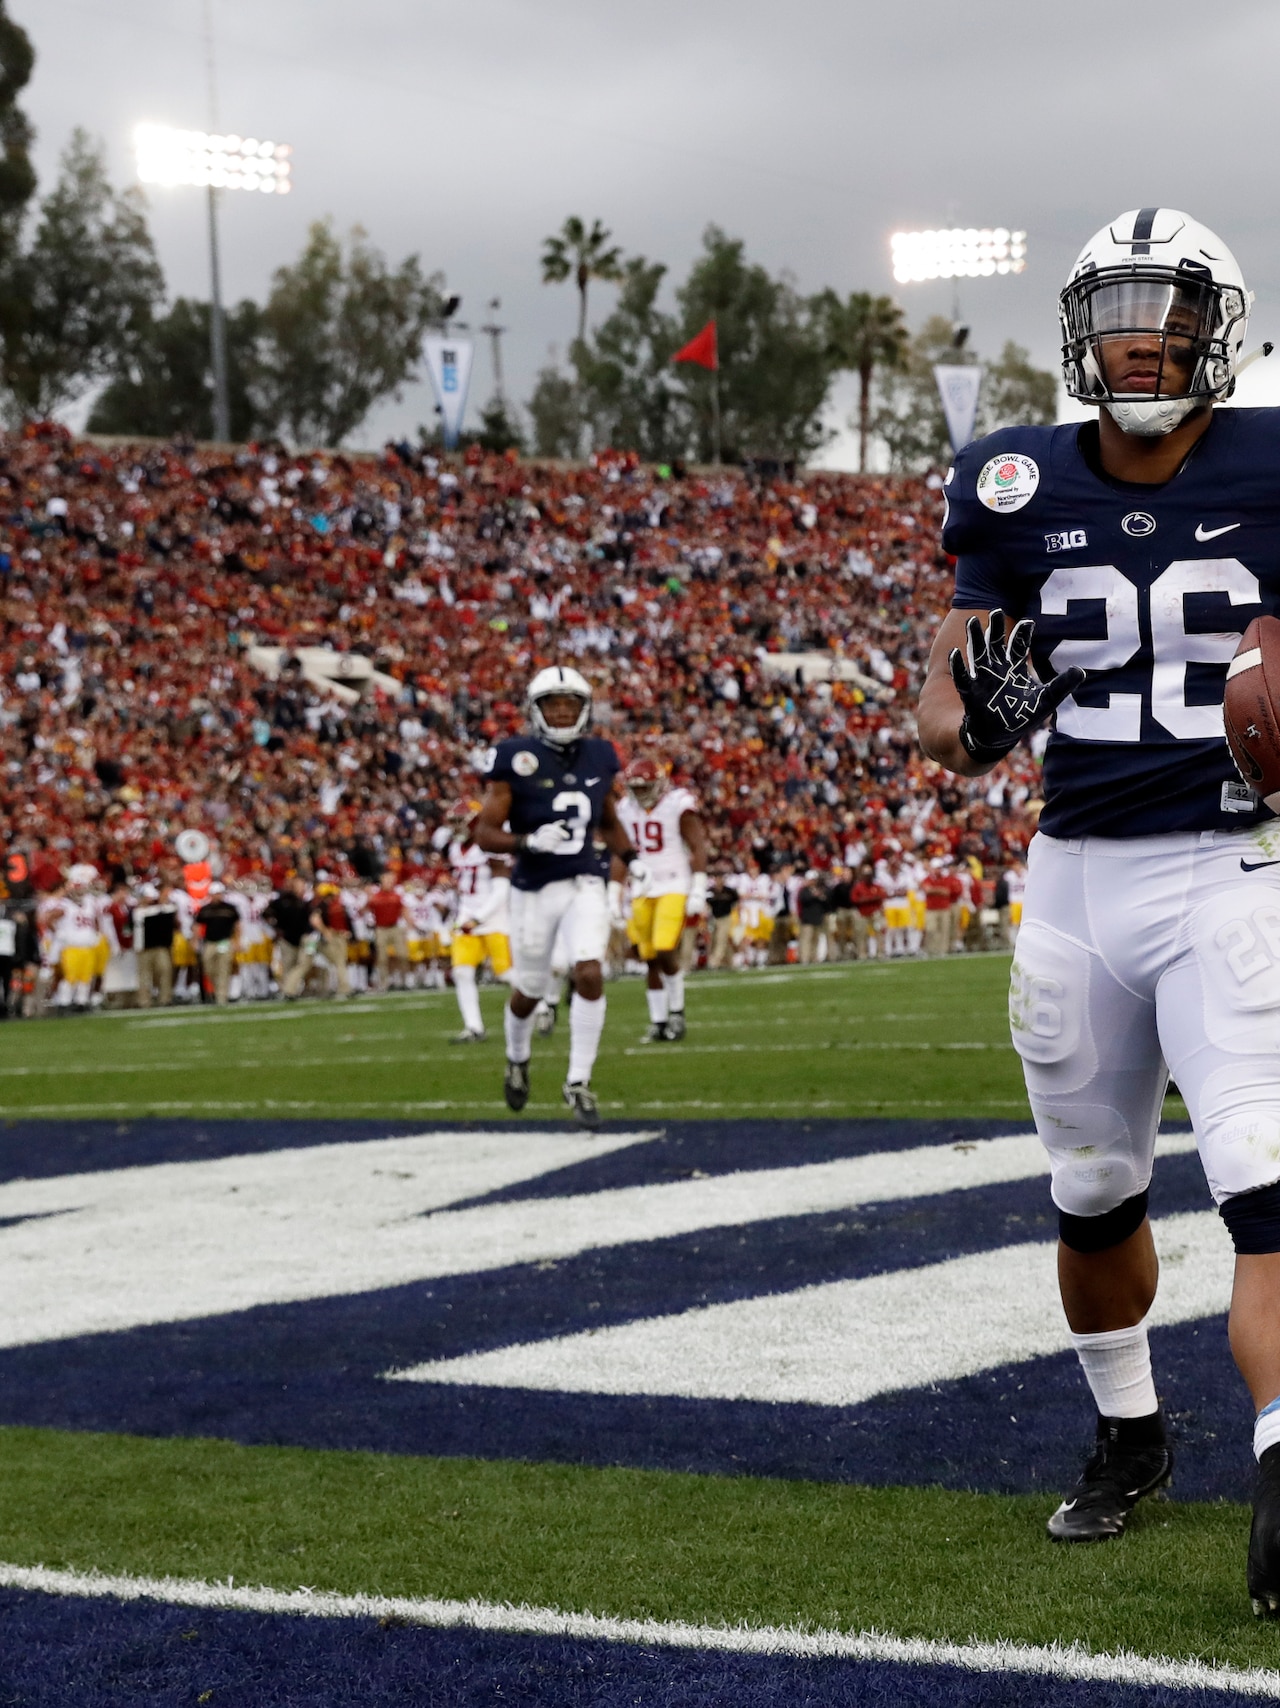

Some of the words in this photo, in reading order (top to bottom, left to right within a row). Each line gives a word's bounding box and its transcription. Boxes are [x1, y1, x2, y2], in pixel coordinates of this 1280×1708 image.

[980, 464, 994, 489] ROSE
[993, 455, 1020, 466] BOWL
[1021, 459, 1037, 481] GAME
[1039, 558, 1262, 742] 26
[1234, 788, 1248, 798] 42
[552, 791, 592, 855] 3
[632, 821, 664, 853] 19
